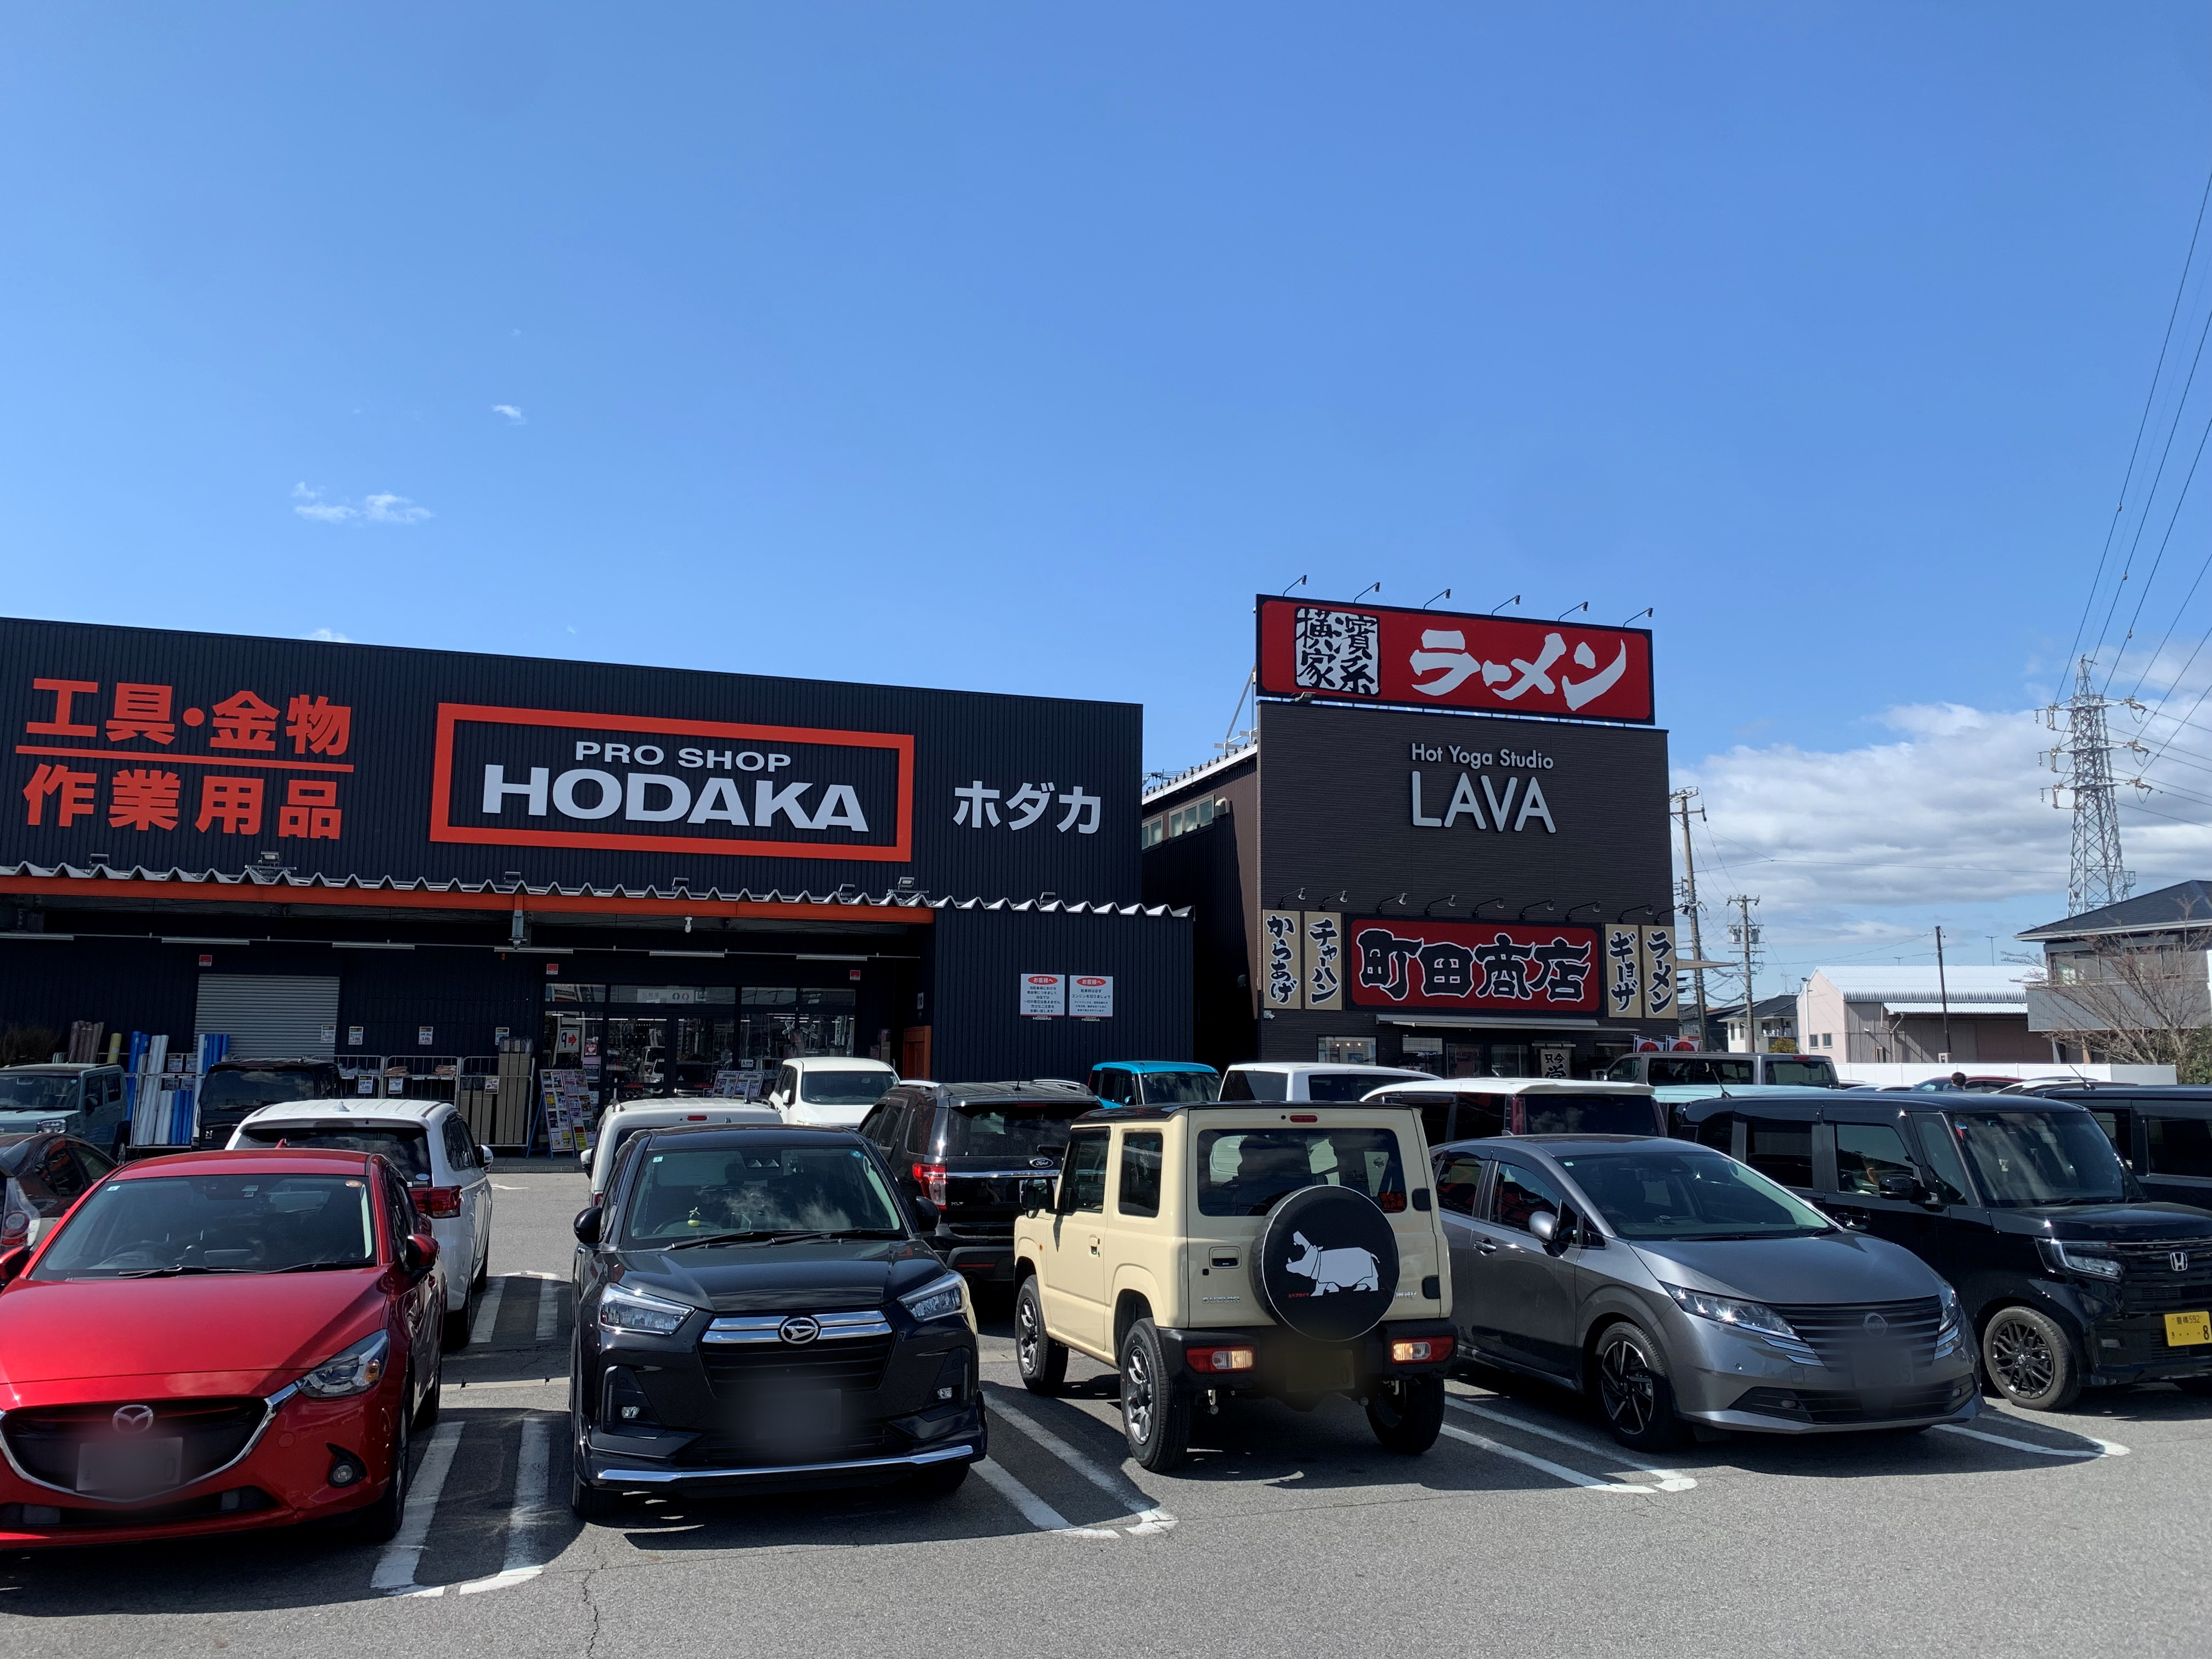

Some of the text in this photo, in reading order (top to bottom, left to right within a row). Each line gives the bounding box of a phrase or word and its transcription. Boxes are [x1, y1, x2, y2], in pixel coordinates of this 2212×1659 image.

[1410, 629, 1626, 711] ラーメン
[27, 679, 351, 755] 工具・金物
[575, 741, 791, 772] PRO SHOP
[1412, 743, 1554, 769] Hot Yoga Studio
[24, 763, 342, 839] 作業用品
[482, 764, 869, 832] HODAKA
[953, 781, 1101, 834] ホダカ
[1412, 771, 1556, 833] LAVA
[1266, 913, 1299, 1005] からあげ
[1308, 917, 1340, 1005] チャーハン
[1356, 928, 1592, 1003] 町田商店
[1609, 930, 1638, 1011] ギョーザ
[1646, 931, 1674, 1013] ラーメン
[1544, 1052, 1566, 1063] 只今
[1201, 1296, 1240, 1304] SUZUKI
